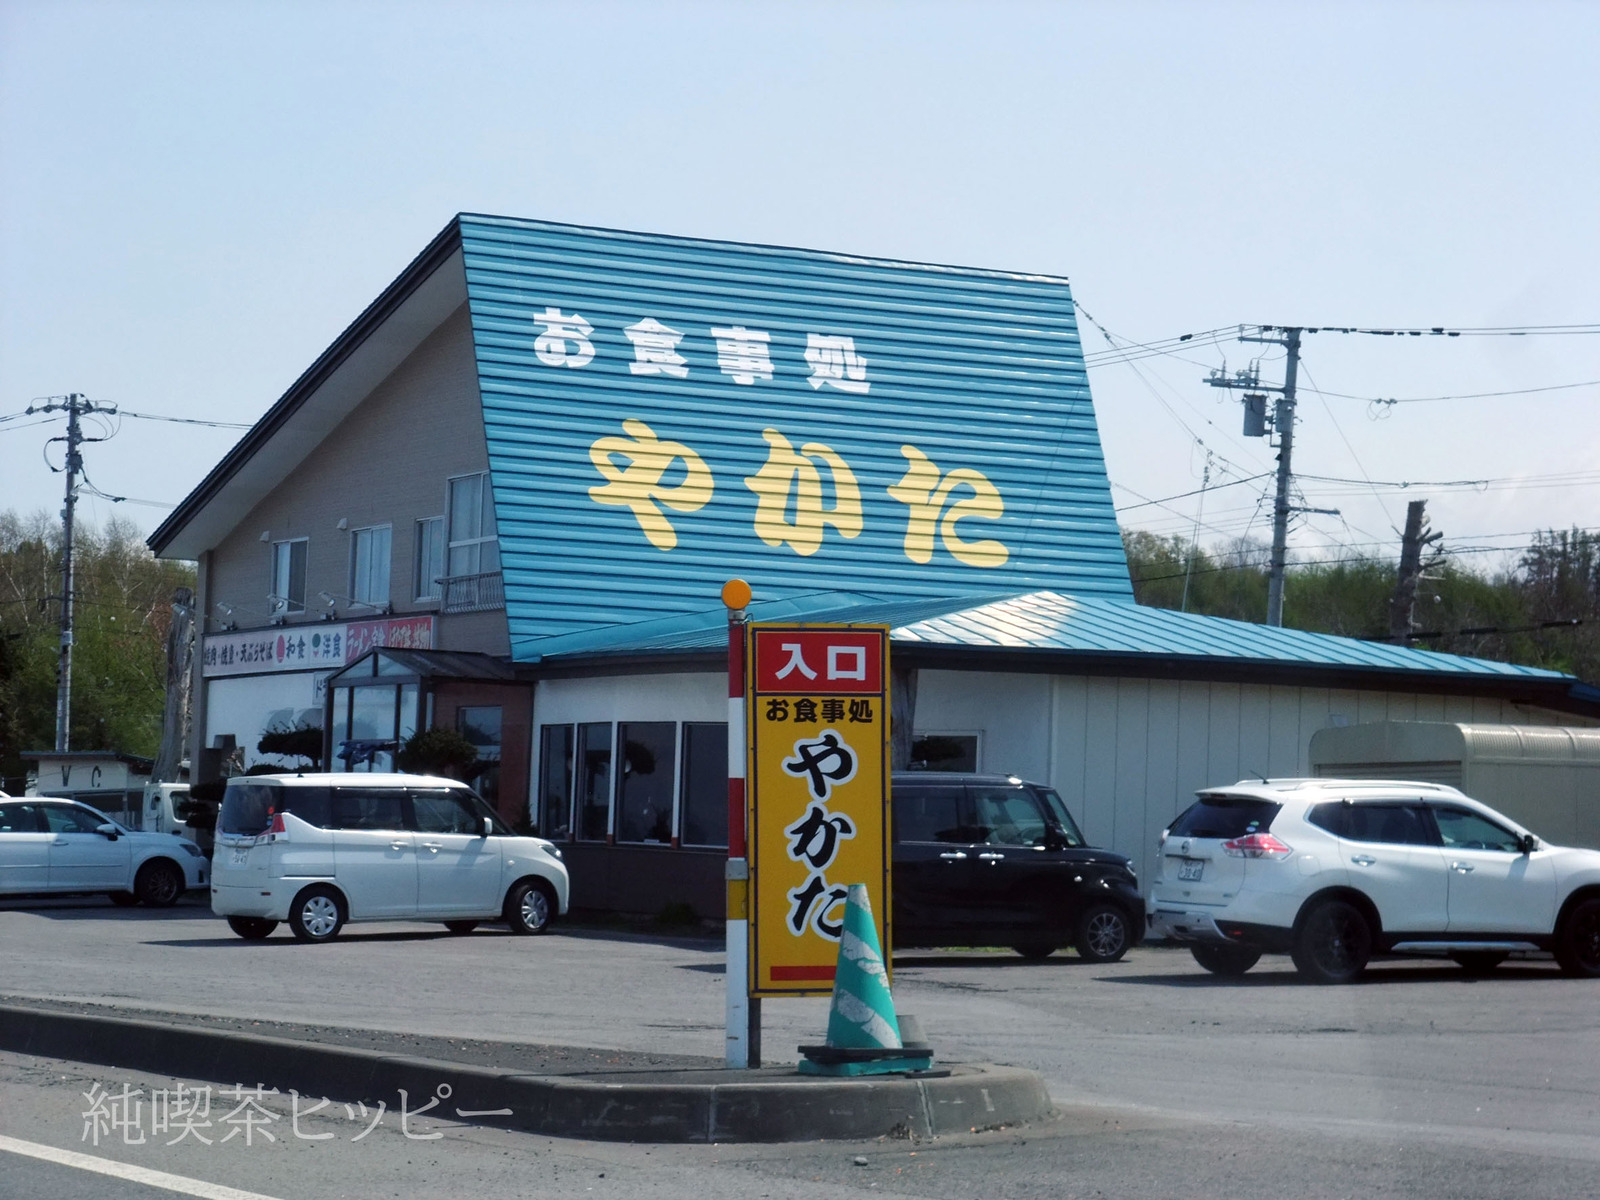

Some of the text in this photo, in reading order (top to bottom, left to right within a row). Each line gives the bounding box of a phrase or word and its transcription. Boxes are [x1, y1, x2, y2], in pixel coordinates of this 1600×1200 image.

[532, 306, 872, 394] お食事処
[587, 418, 1010, 568] やかた
[285, 634, 306, 660] 和食
[322, 632, 342, 659] 洋食
[774, 642, 867, 681] 入口
[765, 698, 874, 724] お食事処
[782, 729, 857, 942] やかた
